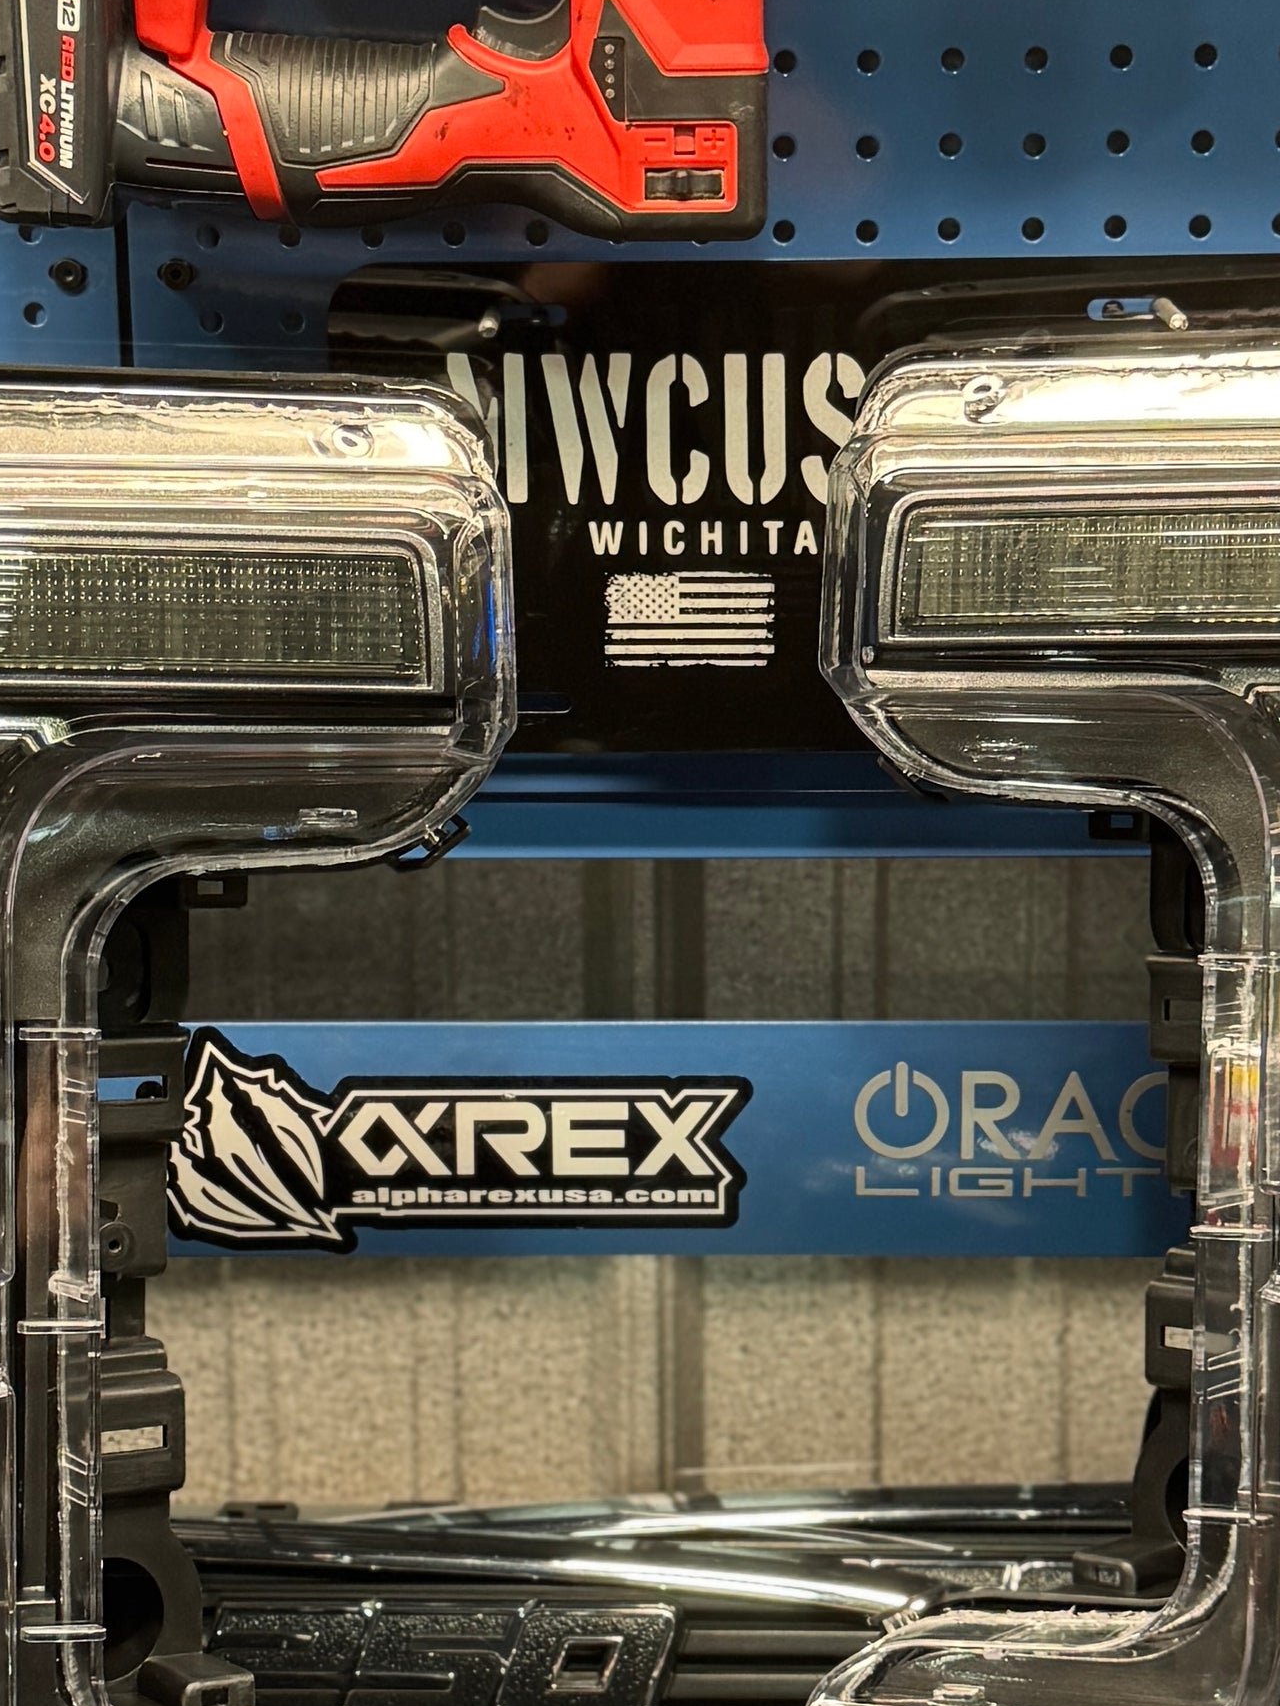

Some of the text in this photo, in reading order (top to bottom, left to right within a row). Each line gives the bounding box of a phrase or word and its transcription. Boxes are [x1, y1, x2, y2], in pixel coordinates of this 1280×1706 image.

[37, 73, 58, 164] XC4.0
[59, 33, 76, 169] REDLITHIUM
[587, 520, 818, 556] WICHITA
[351, 1187, 716, 1207] alpharexusa.com
[855, 1165, 1180, 1198] LIGHT
